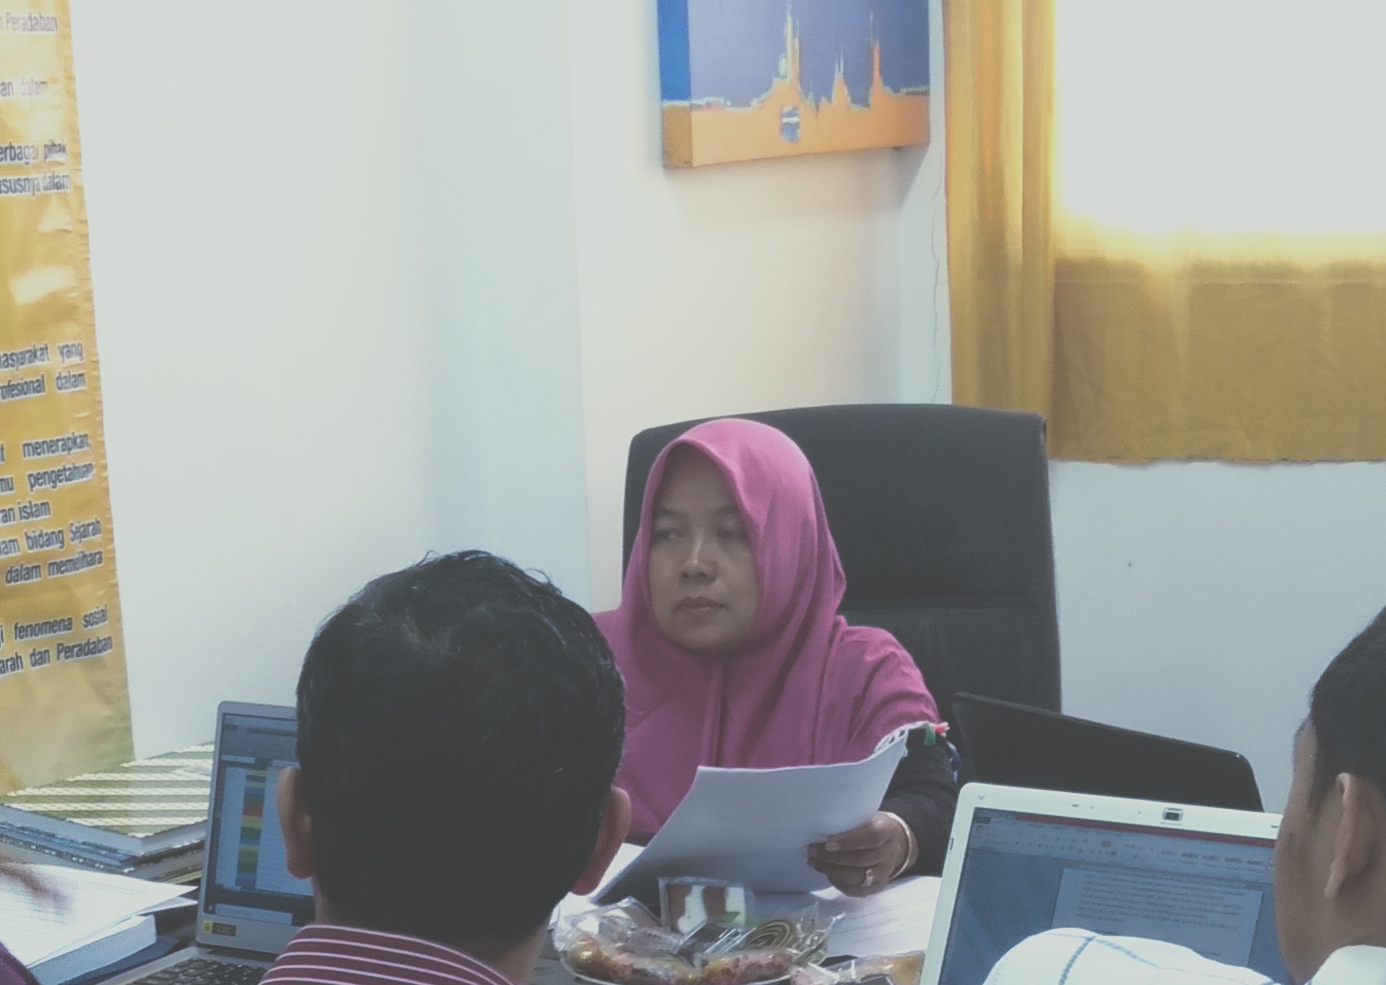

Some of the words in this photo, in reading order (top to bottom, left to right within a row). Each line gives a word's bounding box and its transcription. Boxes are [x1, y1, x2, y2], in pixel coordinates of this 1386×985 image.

[5, 12, 58, 32] Peradaban
[57, 342, 83, 362] yang
[56, 370, 86, 391] dalam
[28, 462, 94, 491] pengetahuan
[18, 500, 51, 520] islam
[24, 529, 64, 549] bidang
[69, 519, 102, 543] Sejarah
[5, 564, 42, 585] dalam
[47, 550, 103, 576] memelihara
[14, 617, 73, 640] fenomena
[83, 605, 108, 628] sosial
[29, 647, 51, 667] dan
[56, 635, 112, 661] Peradaban
